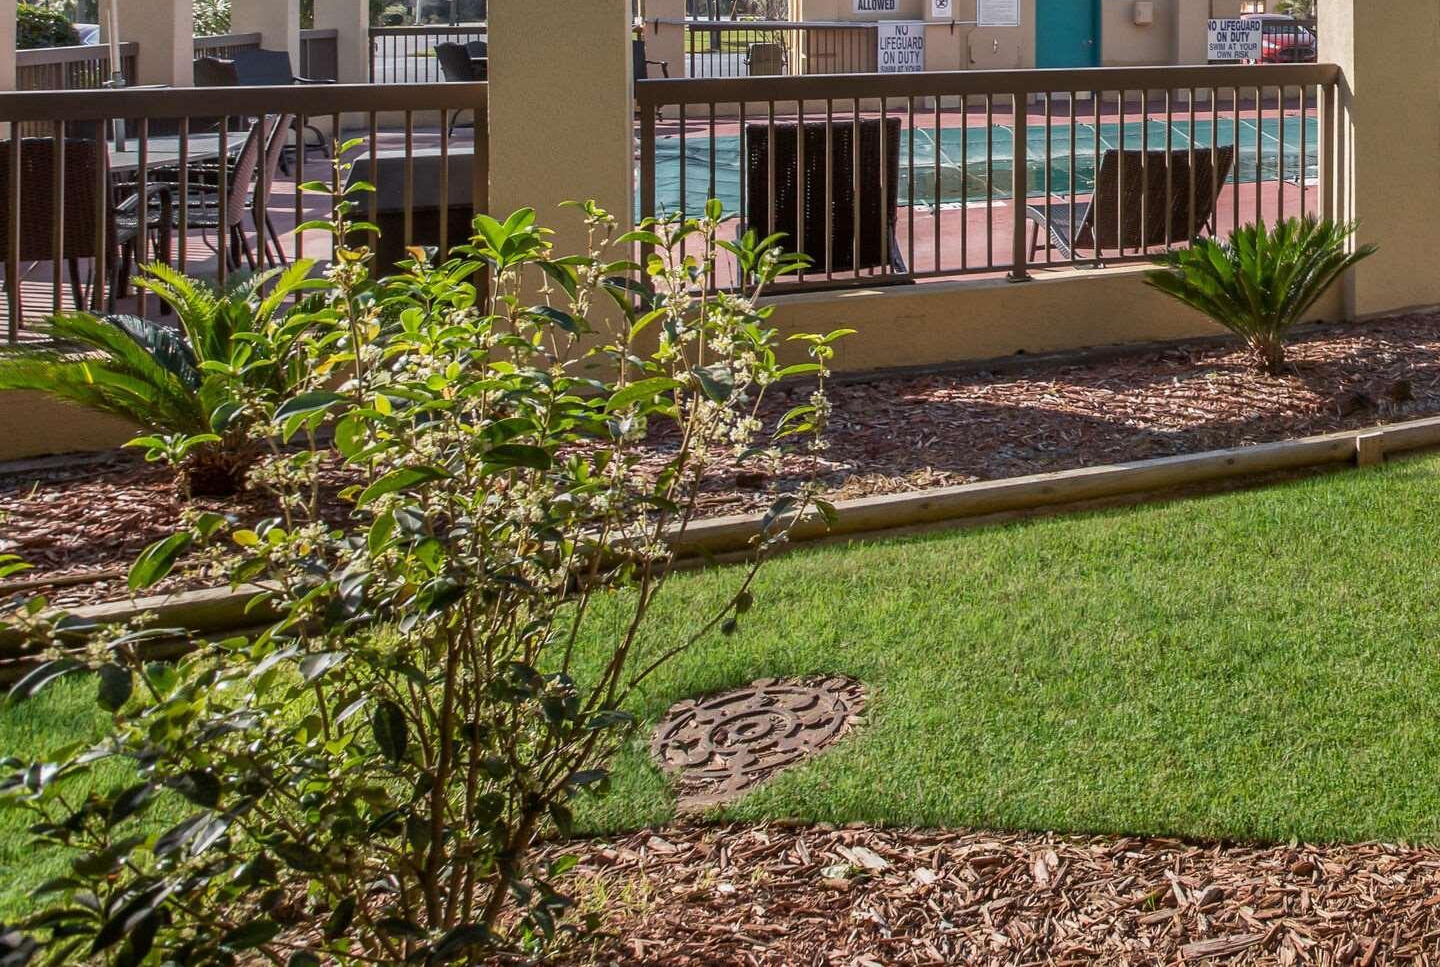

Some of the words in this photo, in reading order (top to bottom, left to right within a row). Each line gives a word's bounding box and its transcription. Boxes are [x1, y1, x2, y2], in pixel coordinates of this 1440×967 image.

[895, 25, 909, 35] NO
[1208, 20, 1217, 31] NO
[1220, 20, 1260, 31] LIFEGUARD
[1217, 32, 1227, 42] ON
[1231, 32, 1250, 42] DUTY
[880, 37, 923, 50] LIFEGUARD
[1209, 43, 1226, 51] SWIM
[1228, 43, 1237, 51] AT
[1240, 43, 1258, 51] YOUR
[883, 51, 895, 64] ON
[898, 51, 920, 64] DUTY
[1217, 51, 1231, 59] OWN
[1234, 51, 1249, 59] RISK
